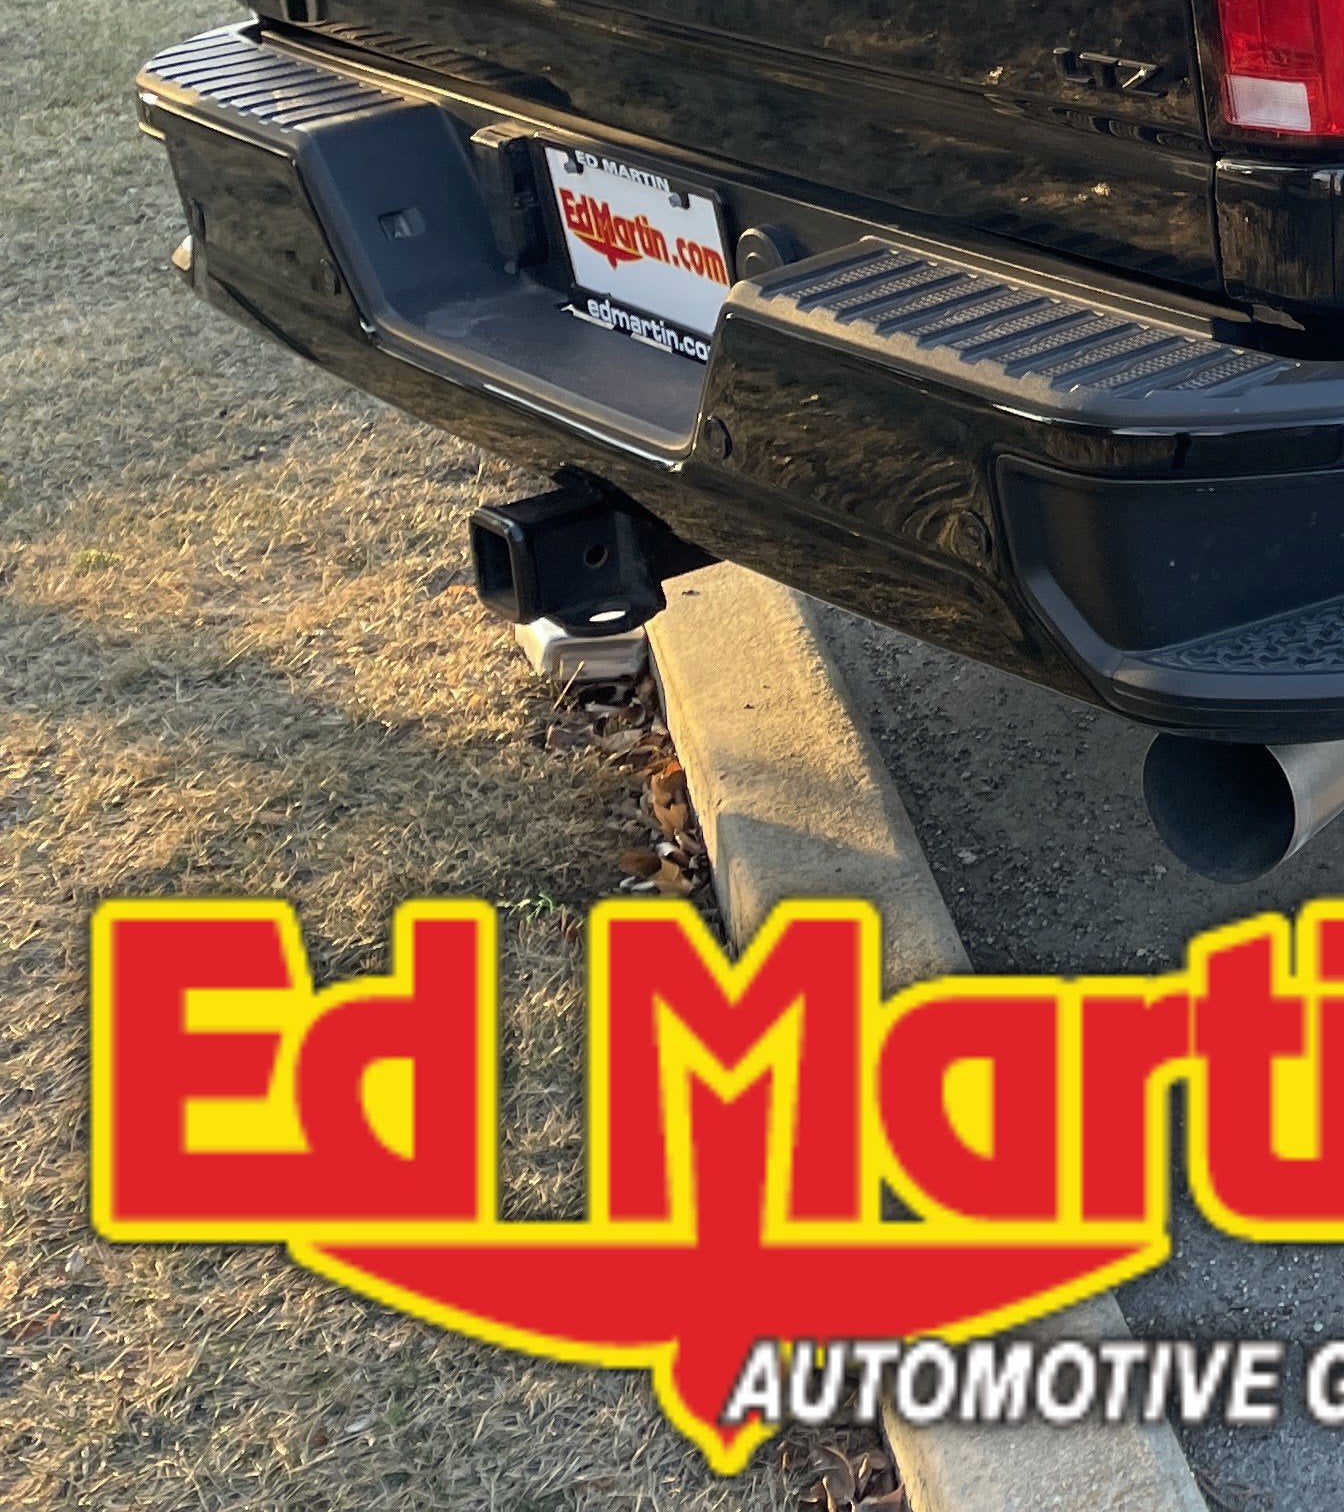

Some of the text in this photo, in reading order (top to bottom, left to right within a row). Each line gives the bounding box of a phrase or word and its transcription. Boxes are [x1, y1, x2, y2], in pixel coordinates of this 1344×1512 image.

[1052, 47, 1168, 99] LTZ
[575, 150, 671, 192] ED MARTIN
[558, 187, 731, 286] EdMartin.com
[586, 297, 711, 362] edmartin.co
